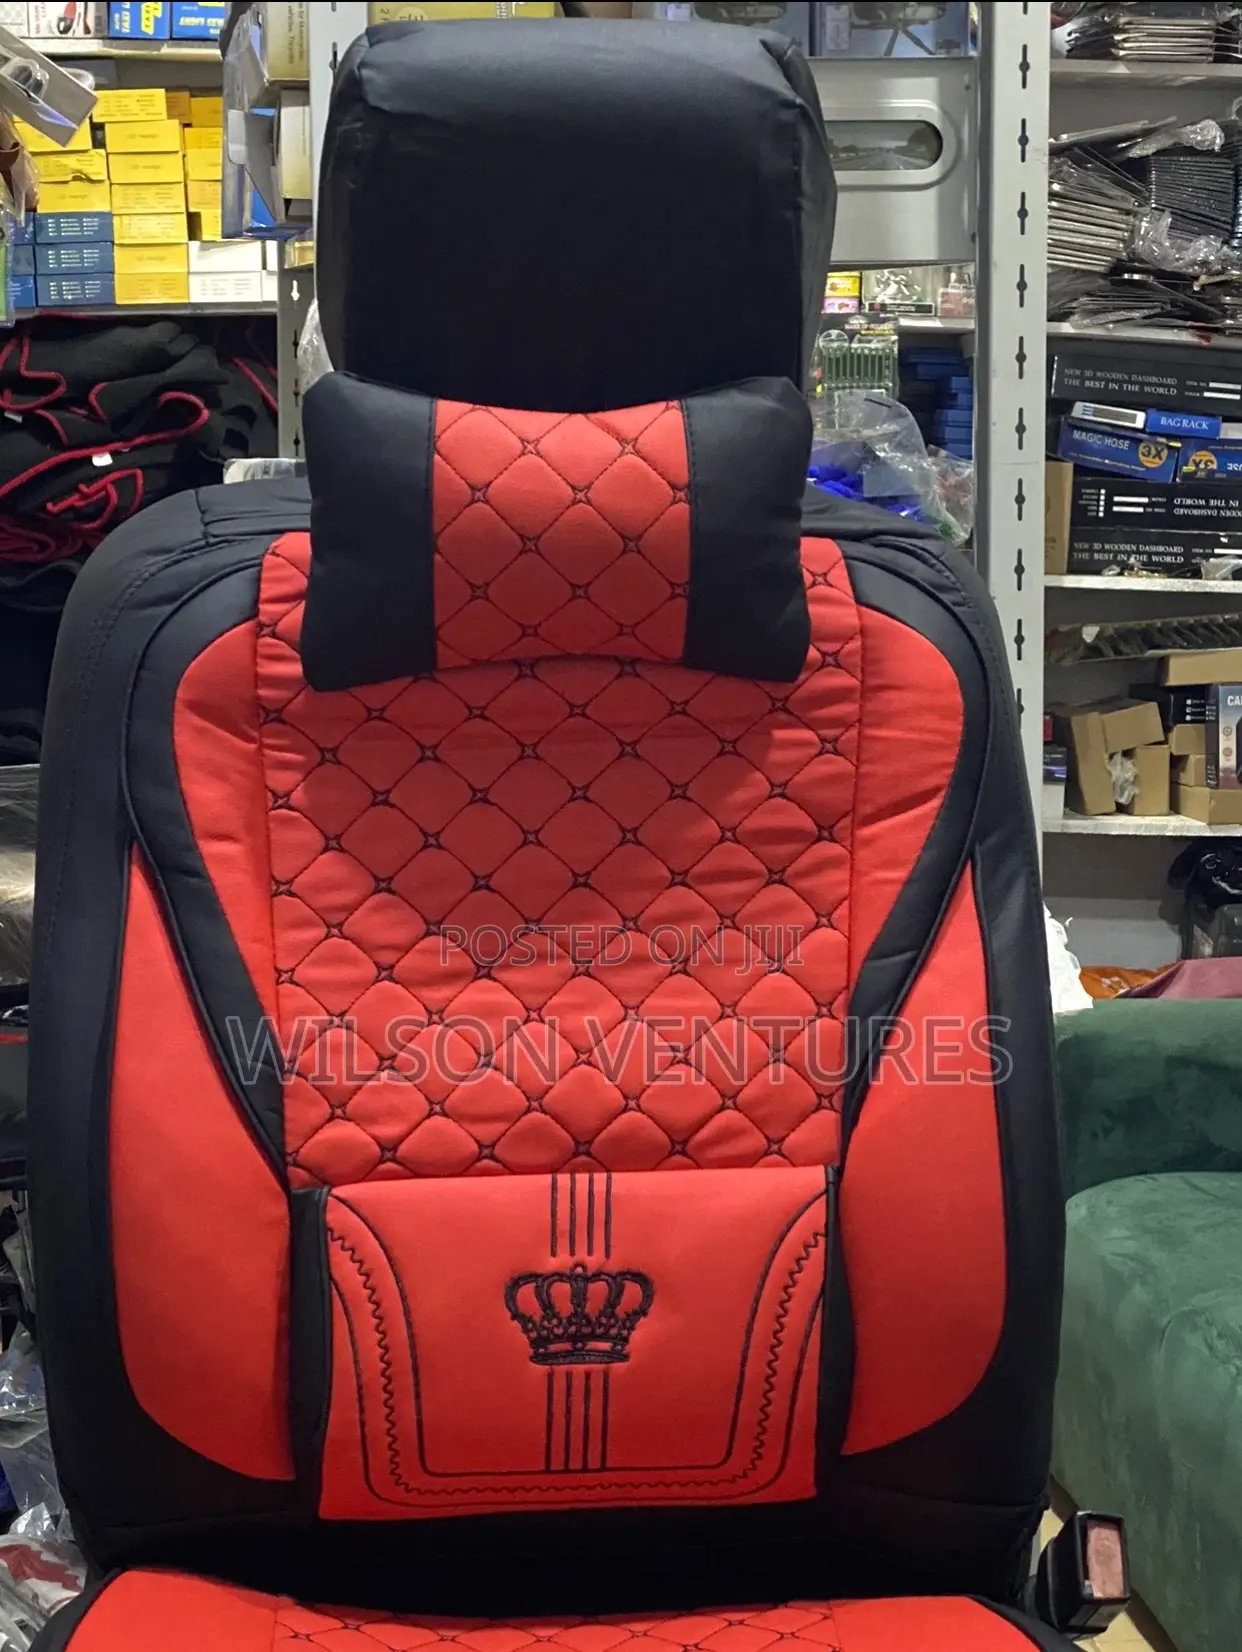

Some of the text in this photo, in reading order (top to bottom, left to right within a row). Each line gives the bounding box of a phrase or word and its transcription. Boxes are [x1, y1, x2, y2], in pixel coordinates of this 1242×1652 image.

[1064, 368, 1081, 378] NEW
[1096, 371, 1129, 382] WOODEN
[1131, 374, 1178, 386] DASHBOARD
[1063, 377, 1081, 388] THE
[1084, 379, 1106, 389] BEST
[1108, 381, 1120, 391] IN
[1122, 383, 1141, 393] THE
[1143, 386, 1178, 396] WORLD
[1160, 416, 1209, 430] BAG RACK
[1072, 430, 1130, 450] MAGIC HOSE
[1140, 443, 1166, 461] 3X
[1173, 497, 1206, 507] WORLD
[1209, 498, 1227, 508] THE
[1228, 498, 1239, 507] IN
[1173, 507, 1218, 517] DASHBOARD
[1104, 543, 1137, 552] WOODEN
[1138, 544, 1184, 553] DASHBOARD
[1072, 551, 1091, 561] THE
[1093, 552, 1114, 561] BEST
[1116, 553, 1128, 562] IN
[1151, 554, 1185, 564] WORLD
